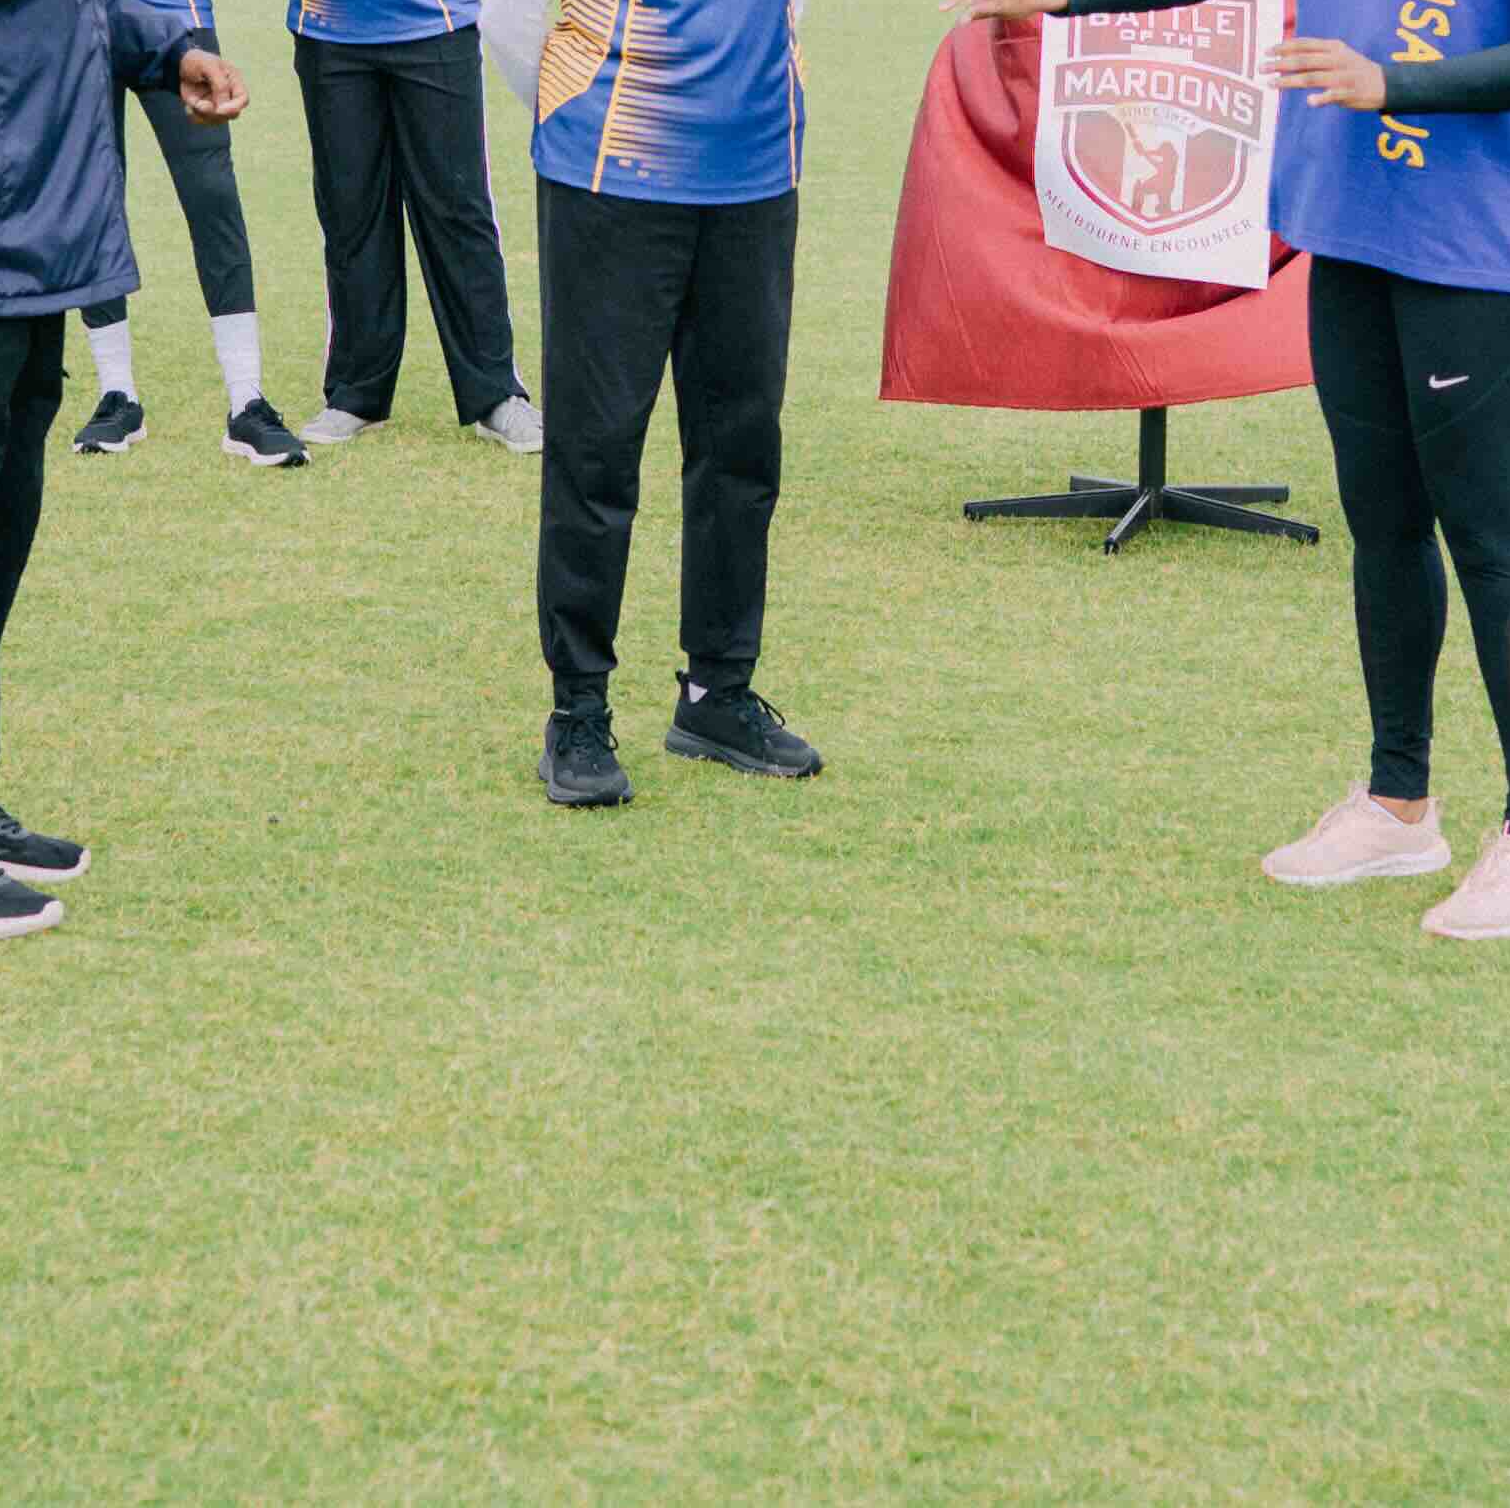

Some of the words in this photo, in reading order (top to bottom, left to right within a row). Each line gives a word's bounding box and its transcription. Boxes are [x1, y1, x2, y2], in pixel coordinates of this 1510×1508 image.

[1119, 28, 1154, 43] OF
[1162, 30, 1212, 49] THE
[1063, 67, 1254, 125] MAROONS
[1044, 188, 1141, 251] MELBOURNE
[1150, 219, 1252, 253] ENCOUNTER
